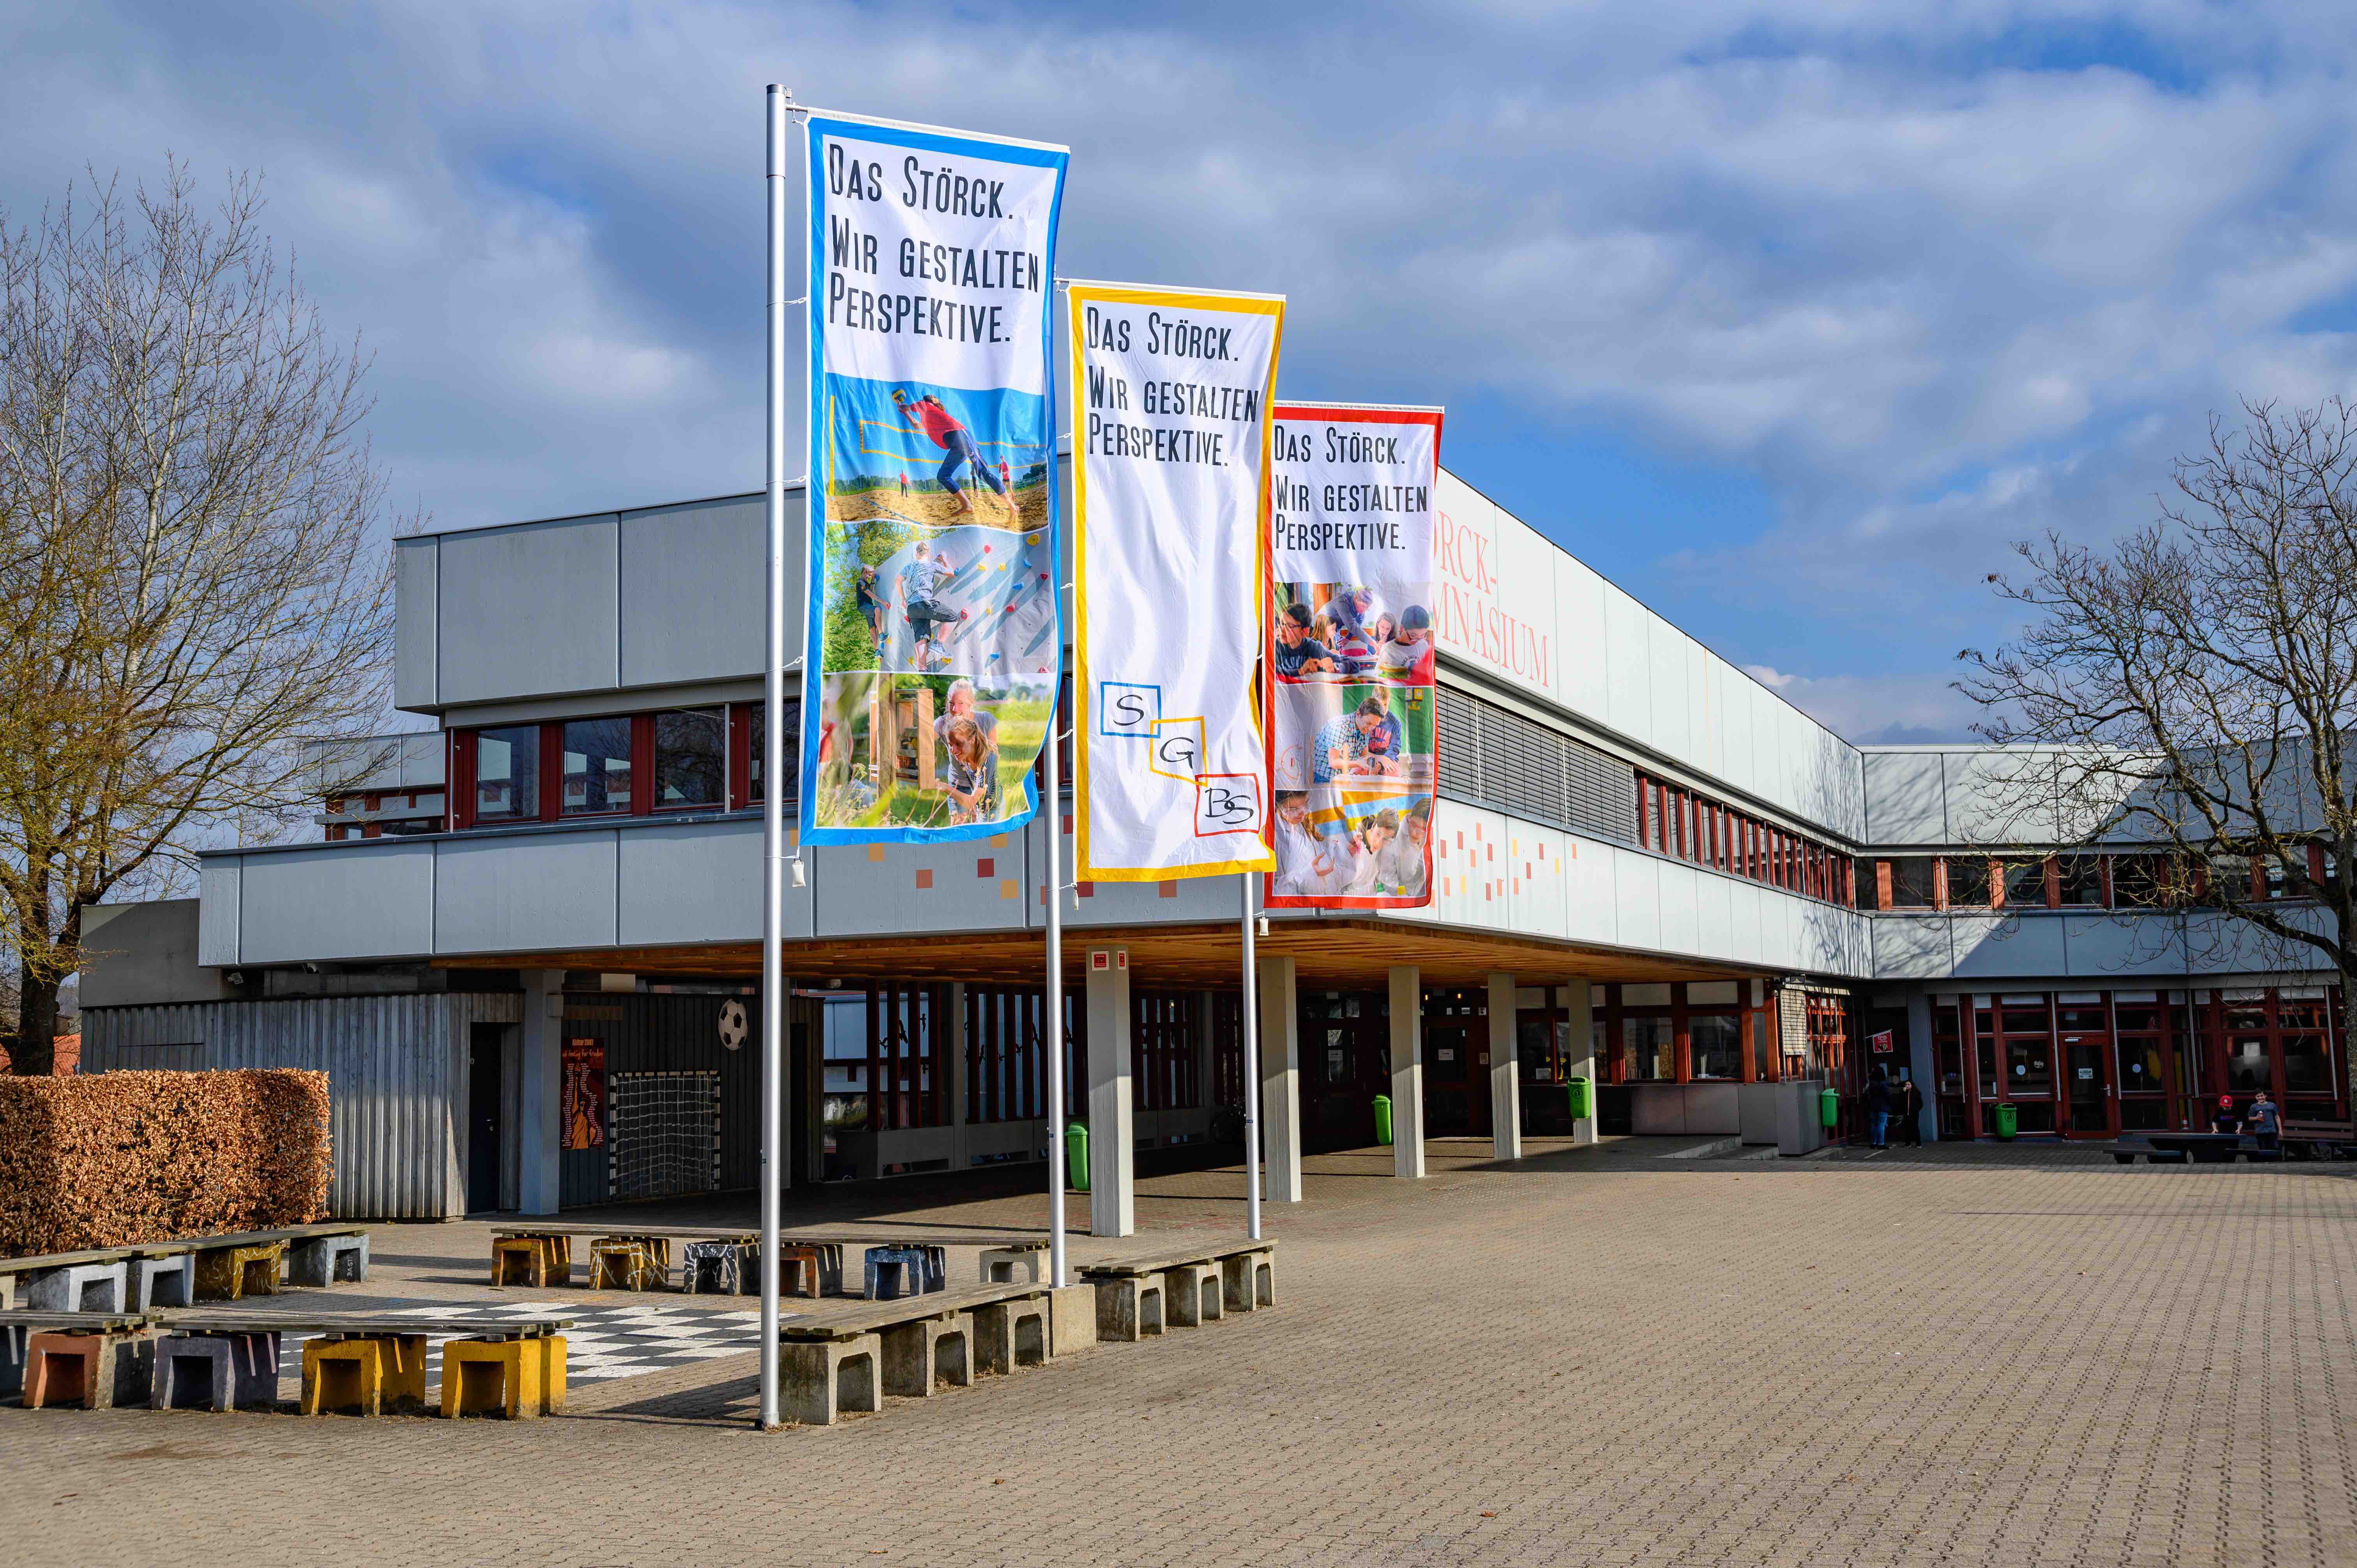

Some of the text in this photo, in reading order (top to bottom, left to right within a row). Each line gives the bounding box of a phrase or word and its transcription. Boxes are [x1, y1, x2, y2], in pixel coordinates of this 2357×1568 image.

[830, 143, 1013, 219] DAS STÖRCK.
[831, 214, 1038, 293] WIR GESTALTEN
[829, 272, 1010, 343] PERSPEKTIVE.
[1087, 307, 1238, 361] DAS STÖRCK.
[1088, 365, 1259, 422] WIR GESTALTEN
[1089, 413, 1228, 466] PERSPEKTIVE.
[1274, 425, 1405, 464] DAS STÖRCK.
[1276, 475, 1427, 512] WIR GESTALTEN
[1276, 514, 1405, 551] PERSPEKTIVE.
[1434, 510, 1497, 595] RCK-
[1113, 694, 1144, 726] S
[1159, 737, 1194, 769] G
